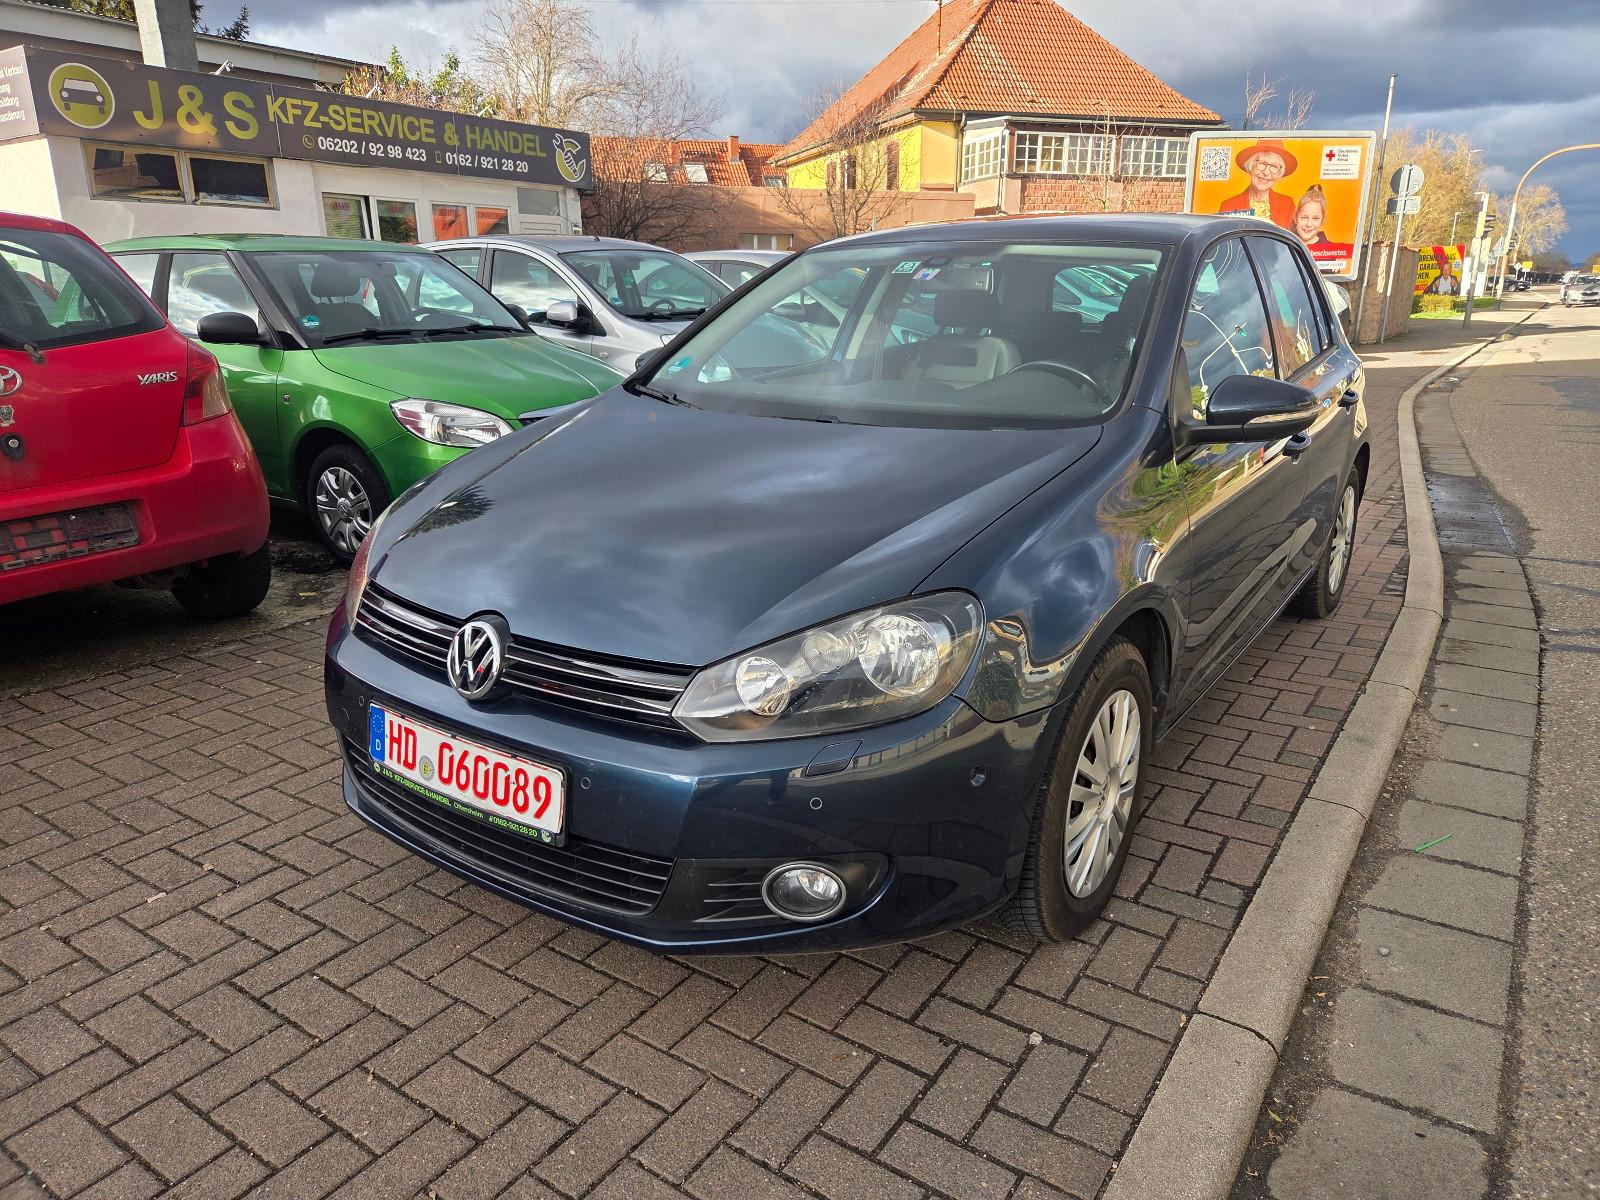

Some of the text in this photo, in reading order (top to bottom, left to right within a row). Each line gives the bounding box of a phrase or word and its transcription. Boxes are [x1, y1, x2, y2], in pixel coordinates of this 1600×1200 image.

[265, 94, 436, 144] KFZ-SERVICE
[444, 122, 460, 147] &
[465, 125, 547, 158] HANDEL
[317, 136, 359, 155] 06202
[368, 142, 385, 157] 92
[387, 145, 403, 159] 98
[405, 146, 427, 162] 423
[445, 152, 473, 167] 0162
[481, 156, 499, 170] 921
[501, 158, 514, 172] 28
[516, 161, 529, 173] 20
[375, 738, 382, 751] D
[388, 719, 552, 821] HD 060089
